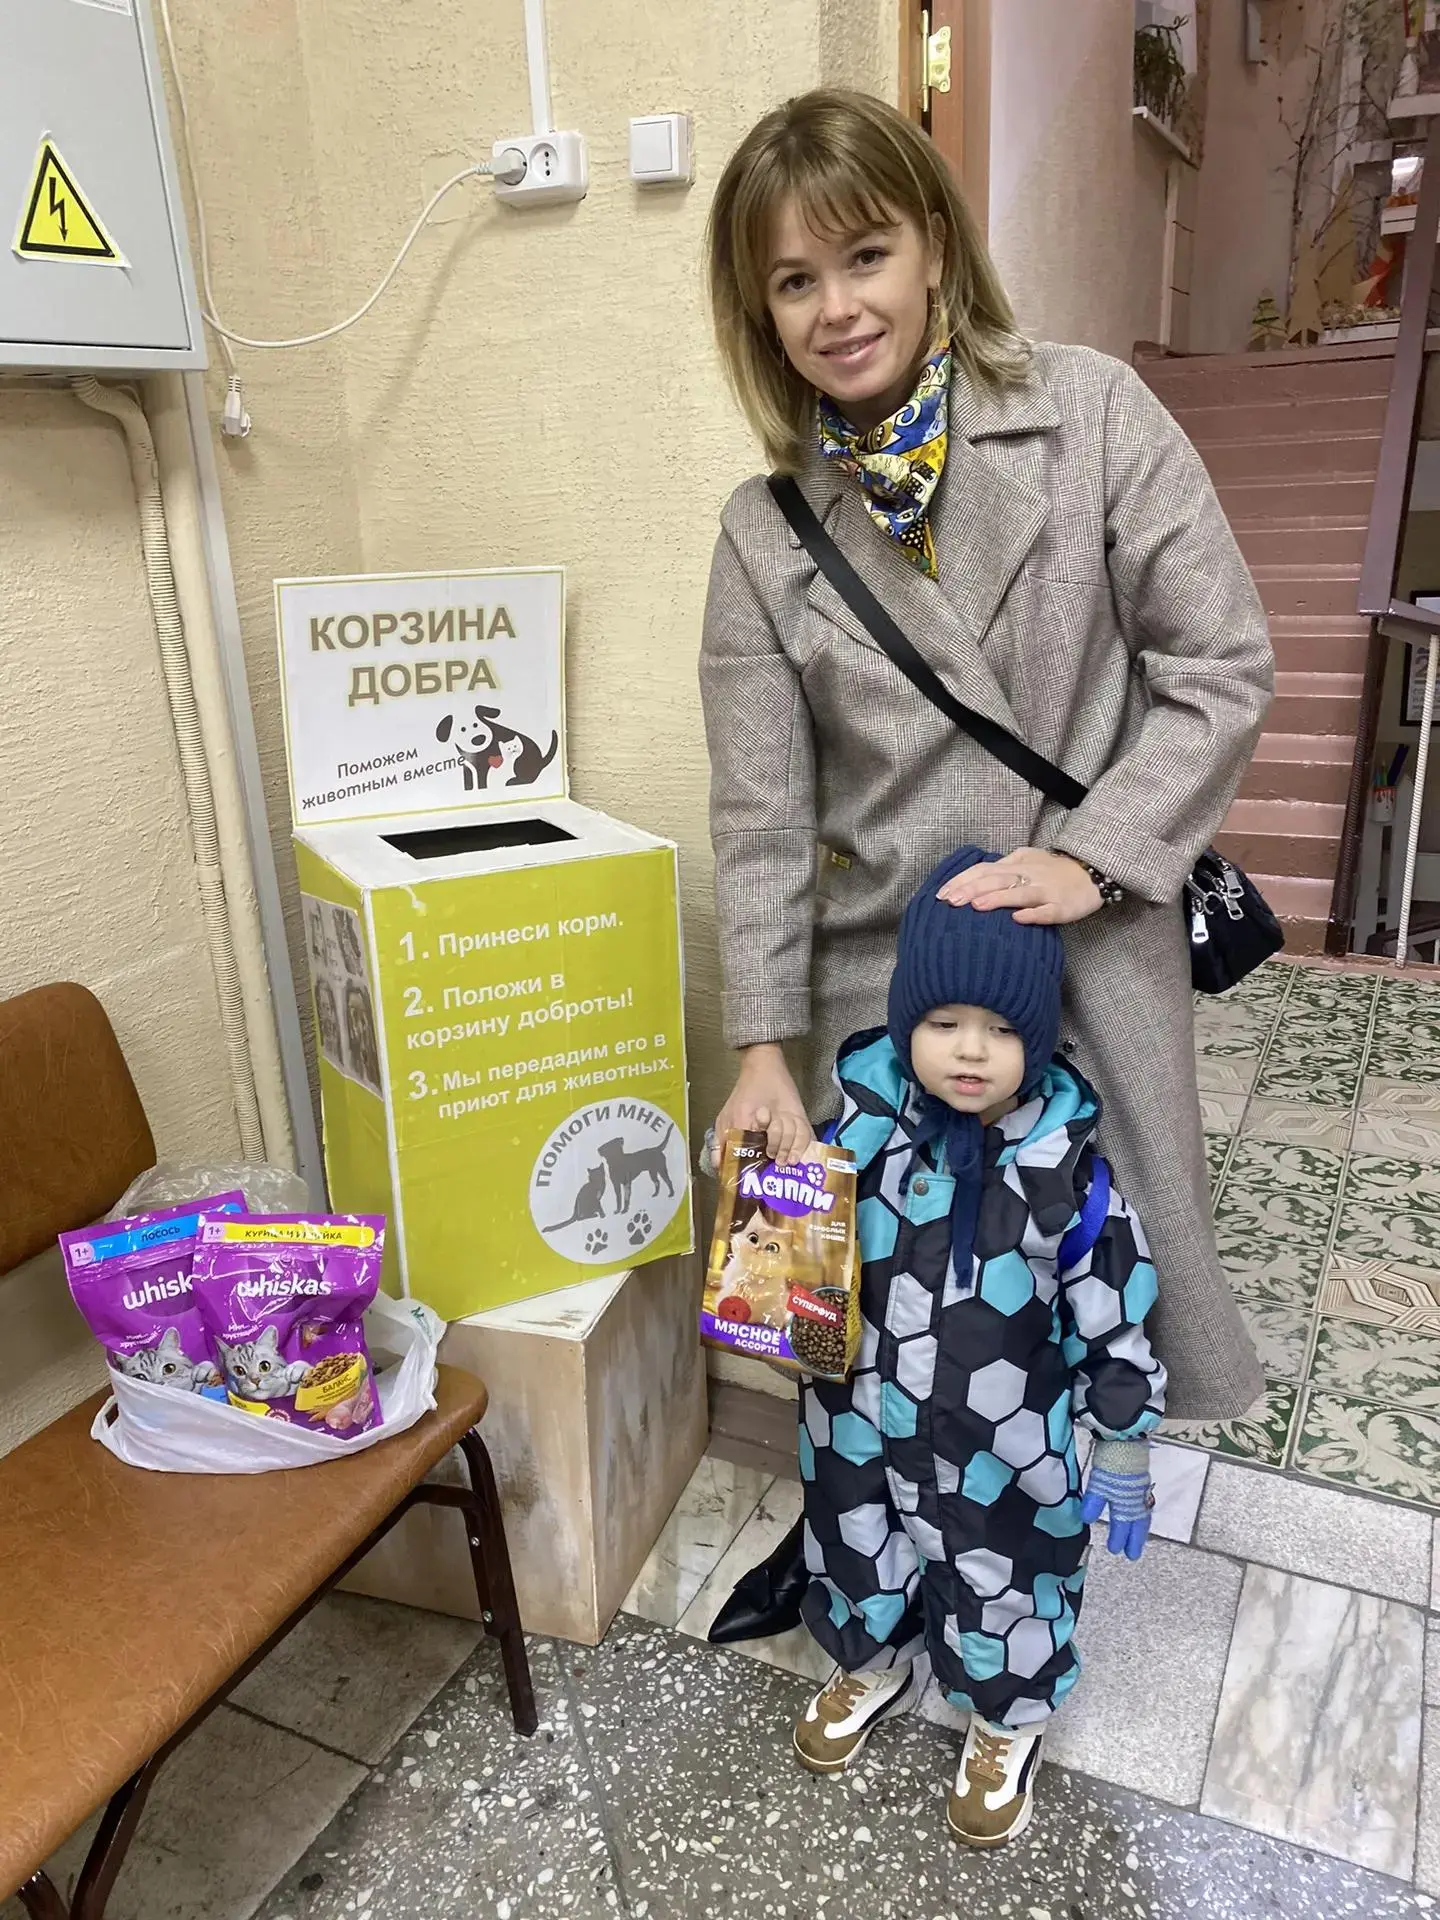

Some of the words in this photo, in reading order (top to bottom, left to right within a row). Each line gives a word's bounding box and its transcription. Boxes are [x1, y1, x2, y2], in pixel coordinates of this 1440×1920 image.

[309, 606, 517, 651] КОРЗИНА
[347, 657, 498, 708] ДОБРА
[301, 775, 399, 810] животным
[403, 754, 466, 783] вместе
[336, 747, 419, 779] Поможем
[399, 931, 430, 962] 1.
[438, 921, 550, 958] Принеси
[557, 911, 624, 938] корм.
[402, 986, 435, 1018] 2.
[442, 975, 543, 1010] Положи
[550, 972, 566, 990] в
[406, 1014, 511, 1050] корзину
[517, 987, 634, 1031] доброты!
[407, 1069, 439, 1101] 3.
[442, 1070, 481, 1093] Мы
[487, 1043, 609, 1082] передадим
[614, 1036, 648, 1057] его
[653, 1033, 667, 1048] в
[438, 1089, 511, 1120] приют
[515, 1080, 557, 1104] для
[563, 1056, 676, 1092] животных.
[535, 1105, 611, 1188] ПОМОГИ
[616, 1103, 667, 1134] МНЕ
[733, 1147, 755, 1158] 350
[122, 1270, 194, 1310] whisk
[236, 1272, 332, 1298] whiskas
[792, 1295, 838, 1323] СУПЕРФУД
[714, 1318, 782, 1347] МЯСНОЕ
[734, 1338, 780, 1355] АССОРТИ
